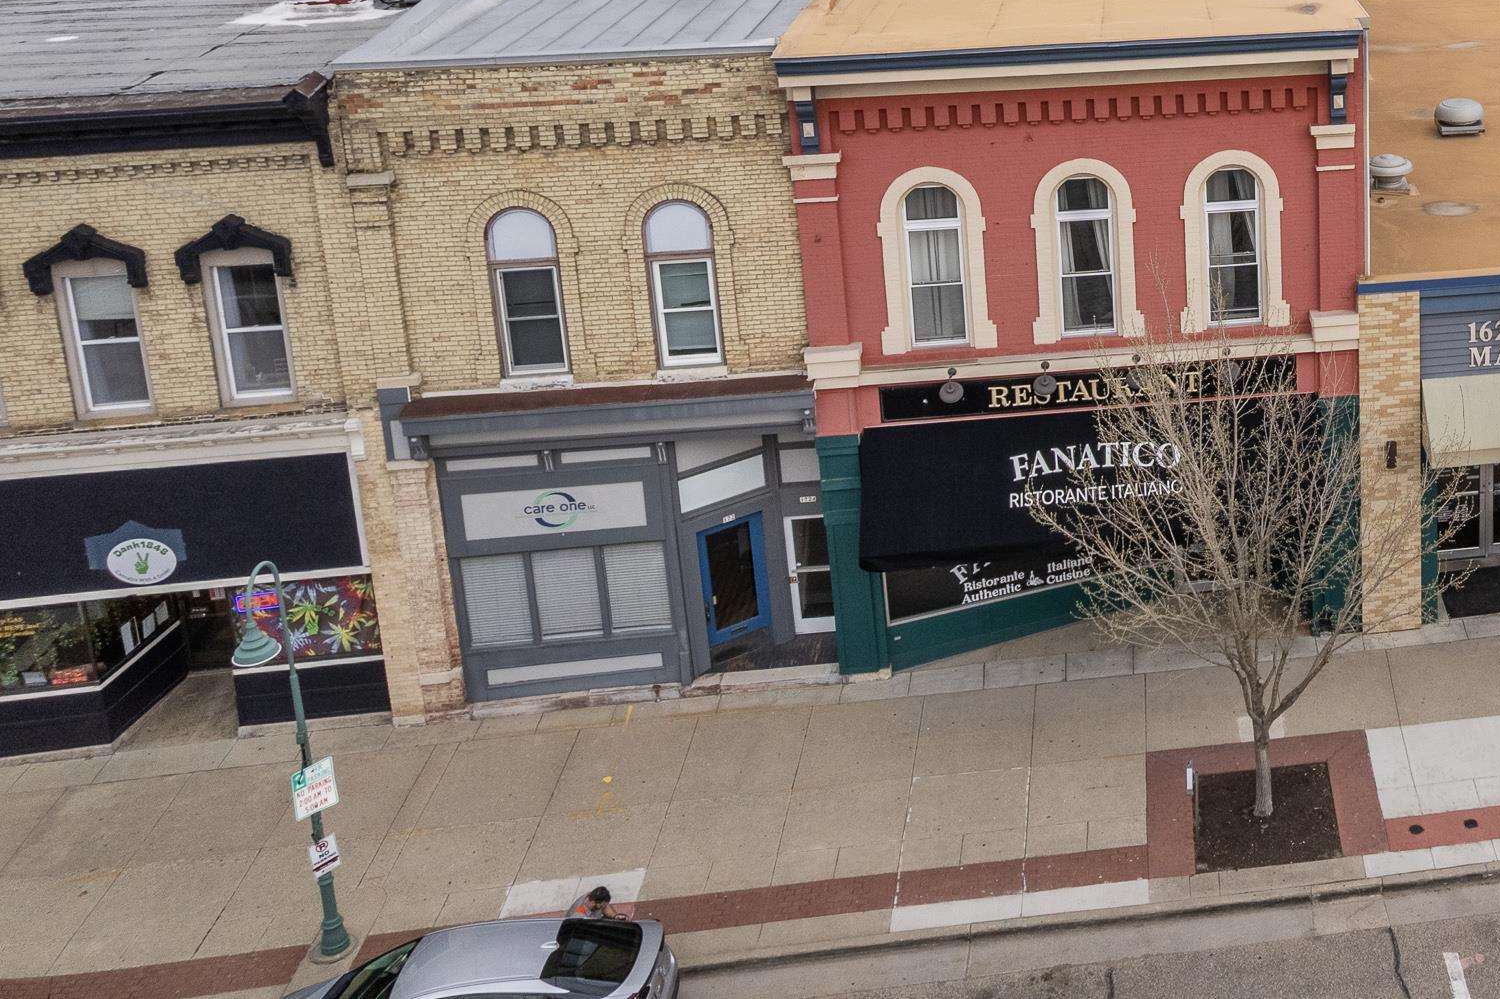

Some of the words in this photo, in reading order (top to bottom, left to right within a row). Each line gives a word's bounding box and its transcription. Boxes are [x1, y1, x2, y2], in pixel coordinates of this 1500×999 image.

[988, 372, 1199, 409] RETAURNT
[1009, 441, 1181, 482] FANATICO
[524, 504, 555, 515] care
[560, 502, 587, 512] one
[1009, 484, 1107, 508] RISTORANTE
[1111, 480, 1183, 501] ITALIANO
[961, 582, 1022, 605] Authentic
[1046, 566, 1091, 585] Cuisine
[963, 569, 1025, 593] Ristorante
[1046, 556, 1095, 574] Italiano
[307, 775, 332, 793] PARKING
[319, 850, 329, 859] NO
